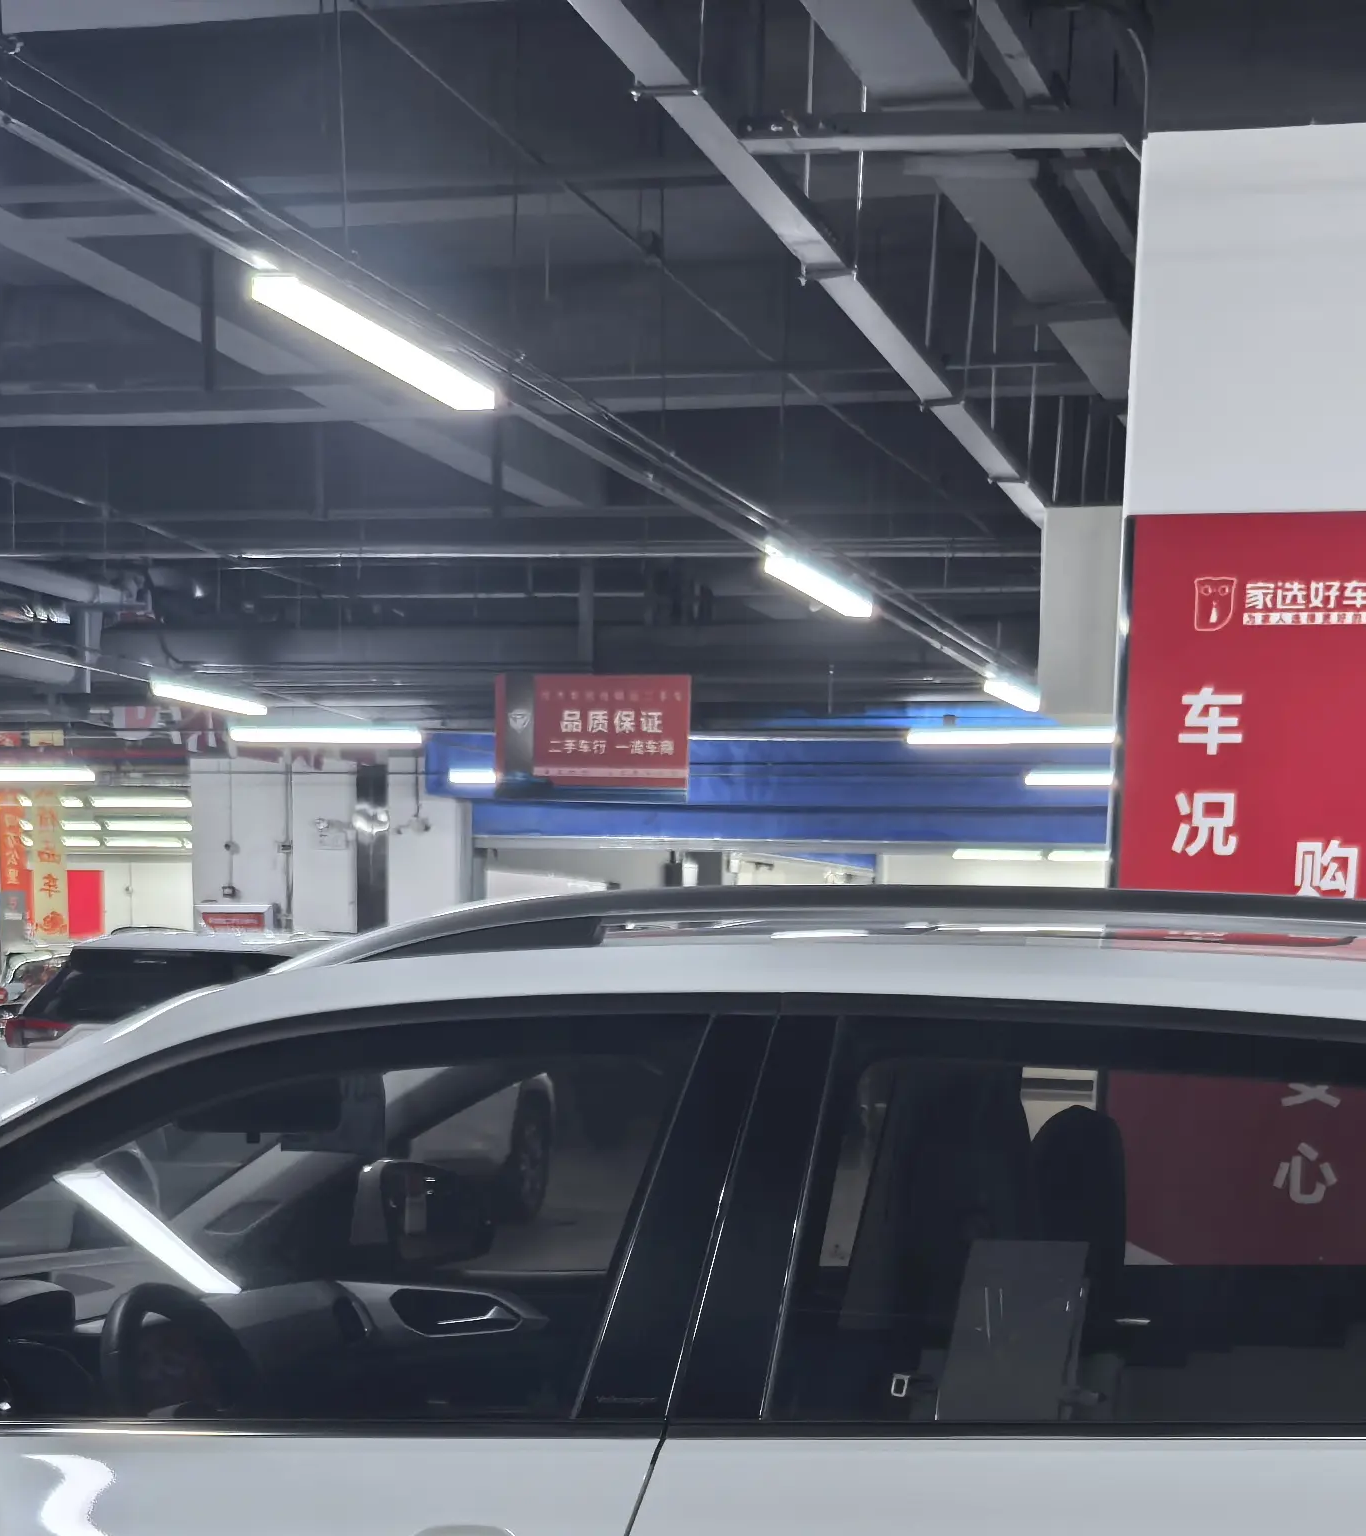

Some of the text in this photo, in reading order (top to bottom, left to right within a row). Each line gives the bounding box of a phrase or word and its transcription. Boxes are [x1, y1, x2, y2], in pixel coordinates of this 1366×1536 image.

[559, 709, 663, 734] 品质保证
[549, 740, 607, 755] 二手车行
